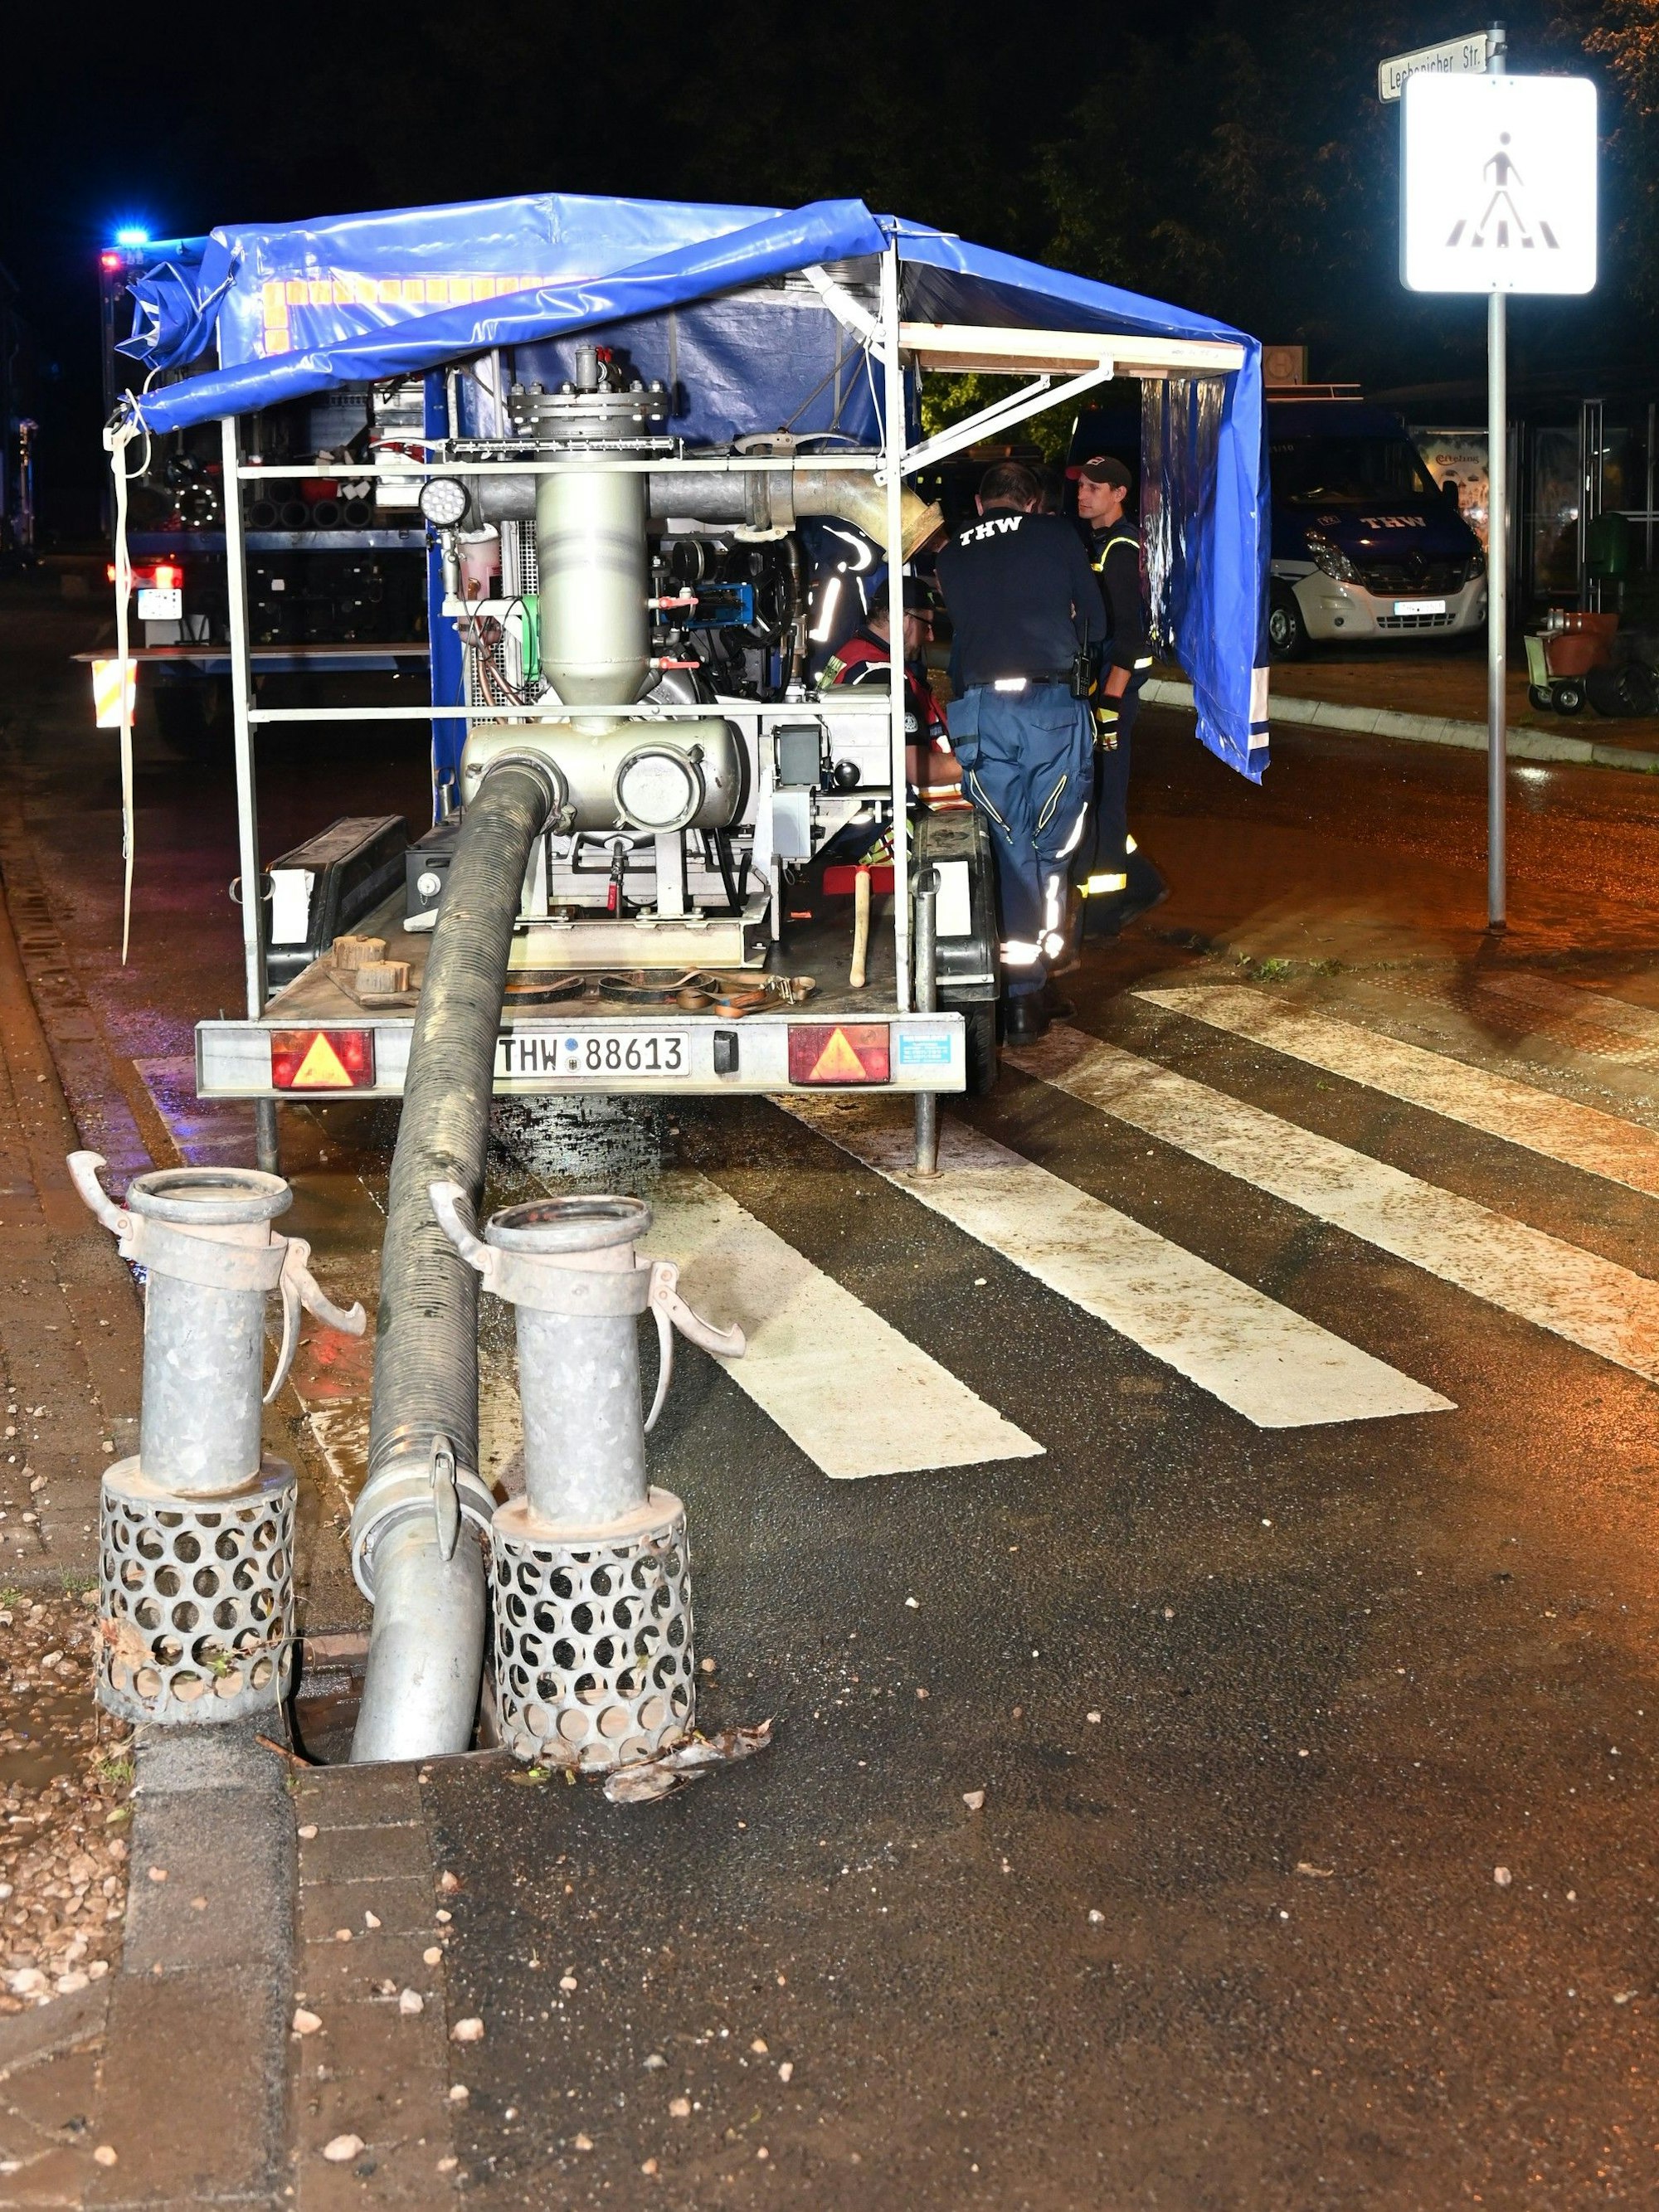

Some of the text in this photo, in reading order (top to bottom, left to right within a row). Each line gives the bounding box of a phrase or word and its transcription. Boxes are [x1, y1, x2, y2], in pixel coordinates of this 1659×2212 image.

[1462, 45, 1480, 68] Str.
[960, 516, 1023, 546] THW
[1360, 516, 1426, 529] THW
[499, 1038, 682, 1072] THW 88613
